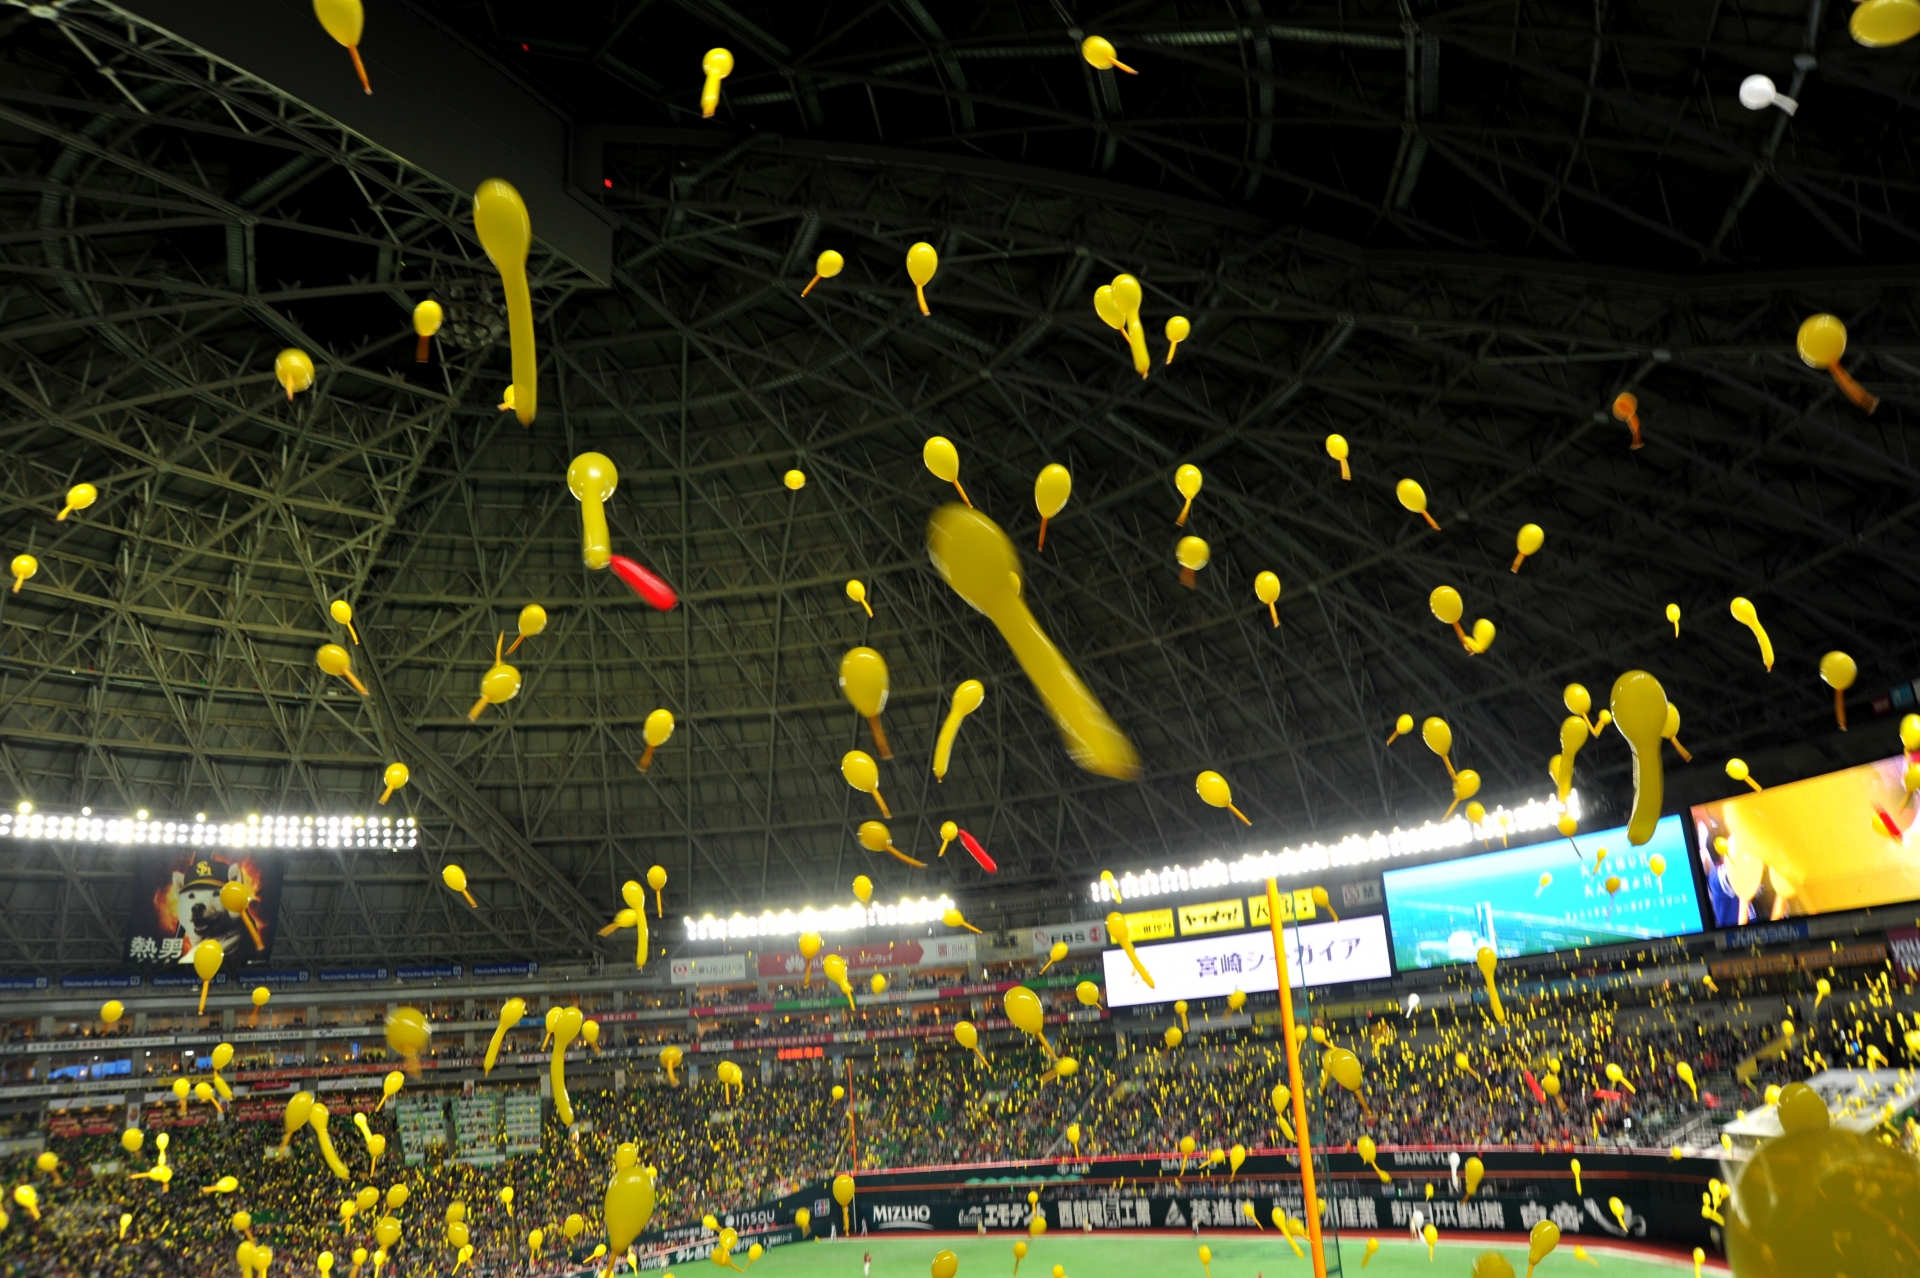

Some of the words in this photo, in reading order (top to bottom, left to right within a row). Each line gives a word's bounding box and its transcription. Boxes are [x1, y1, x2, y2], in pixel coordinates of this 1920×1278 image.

[1050, 930, 1086, 945] FBS
[129, 936, 184, 960] 熱男
[873, 1204, 932, 1223] MIZUHO
